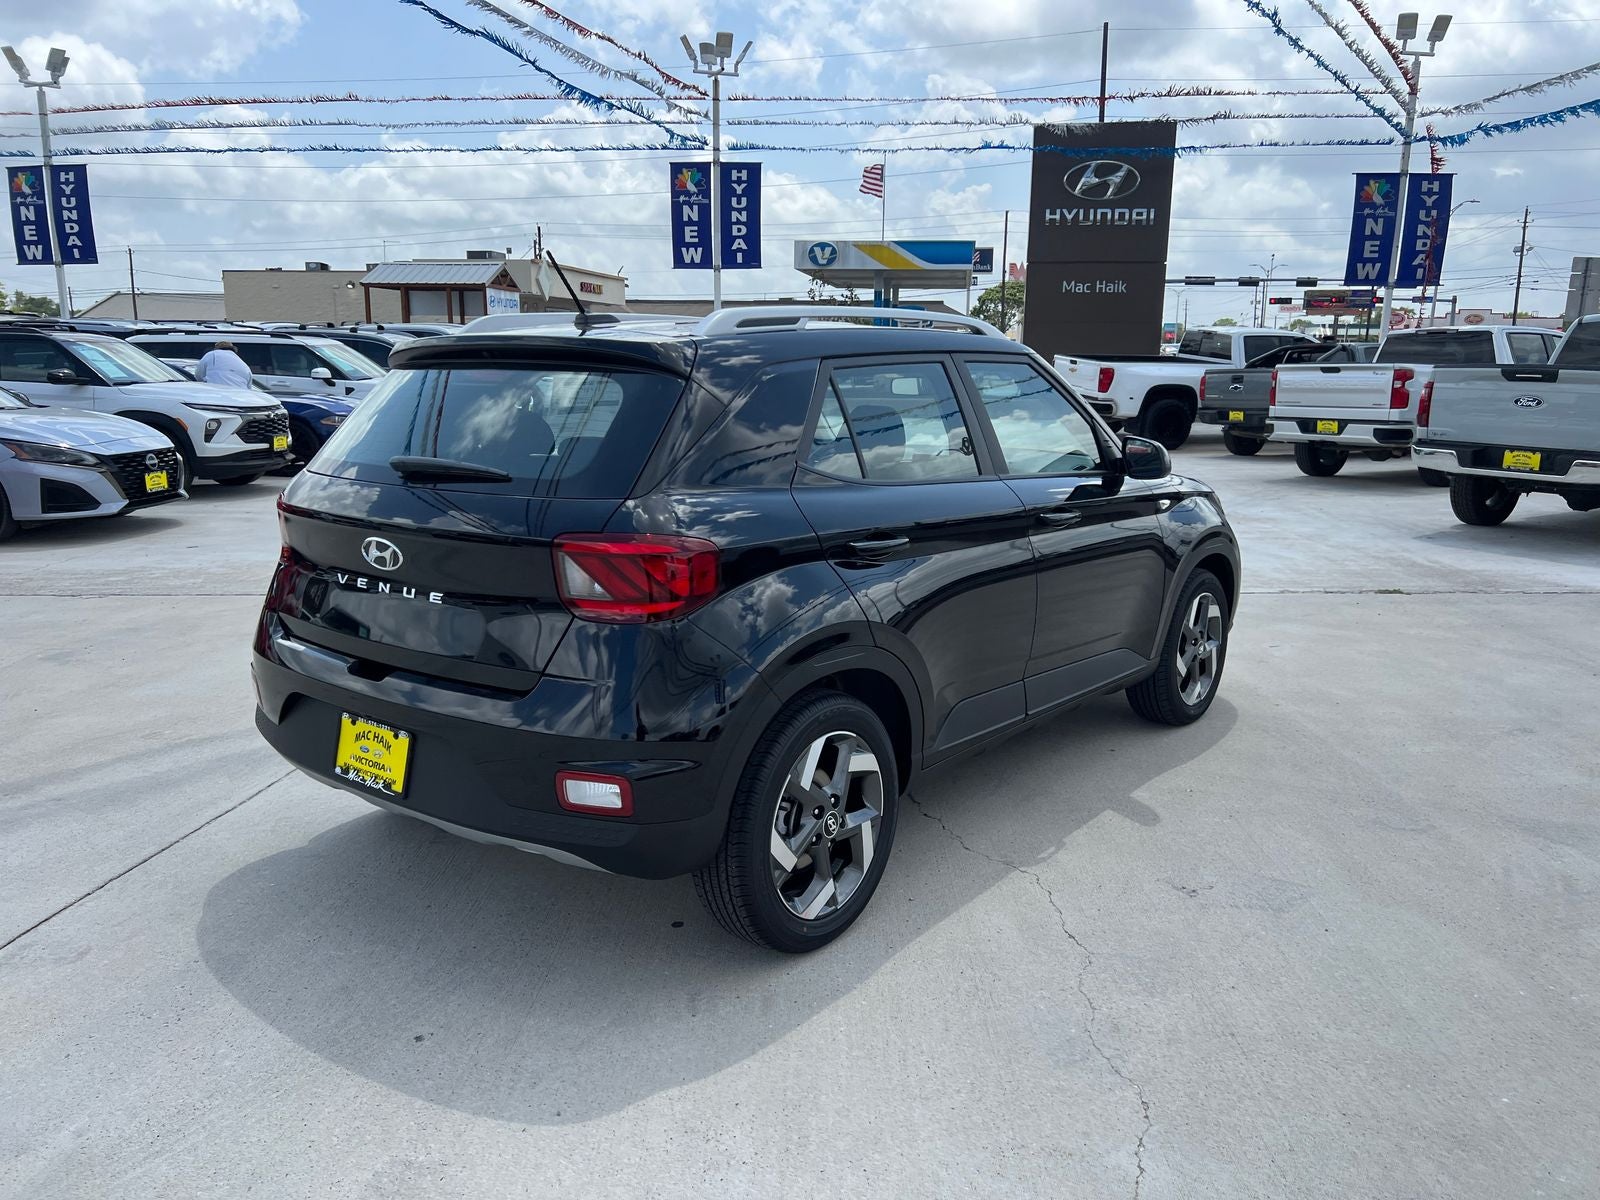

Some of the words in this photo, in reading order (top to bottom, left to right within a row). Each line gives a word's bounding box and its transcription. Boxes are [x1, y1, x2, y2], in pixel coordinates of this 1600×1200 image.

[60, 171, 82, 259] HYUNDAI
[730, 169, 748, 263] HYUNDAI
[1045, 208, 1155, 226] HYUNDAI
[20, 205, 42, 260] NEW
[681, 204, 702, 263] NEW
[1356, 217, 1384, 280] NEW
[1062, 280, 1091, 293] Mac
[1096, 279, 1127, 293] Haik
[1517, 396, 1538, 407] Ford
[337, 572, 444, 604] VENUE
[354, 730, 372, 744] MAC
[372, 731, 392, 754] HAIK
[344, 769, 365, 785] Mac
[355, 754, 387, 772] VICTORIA
